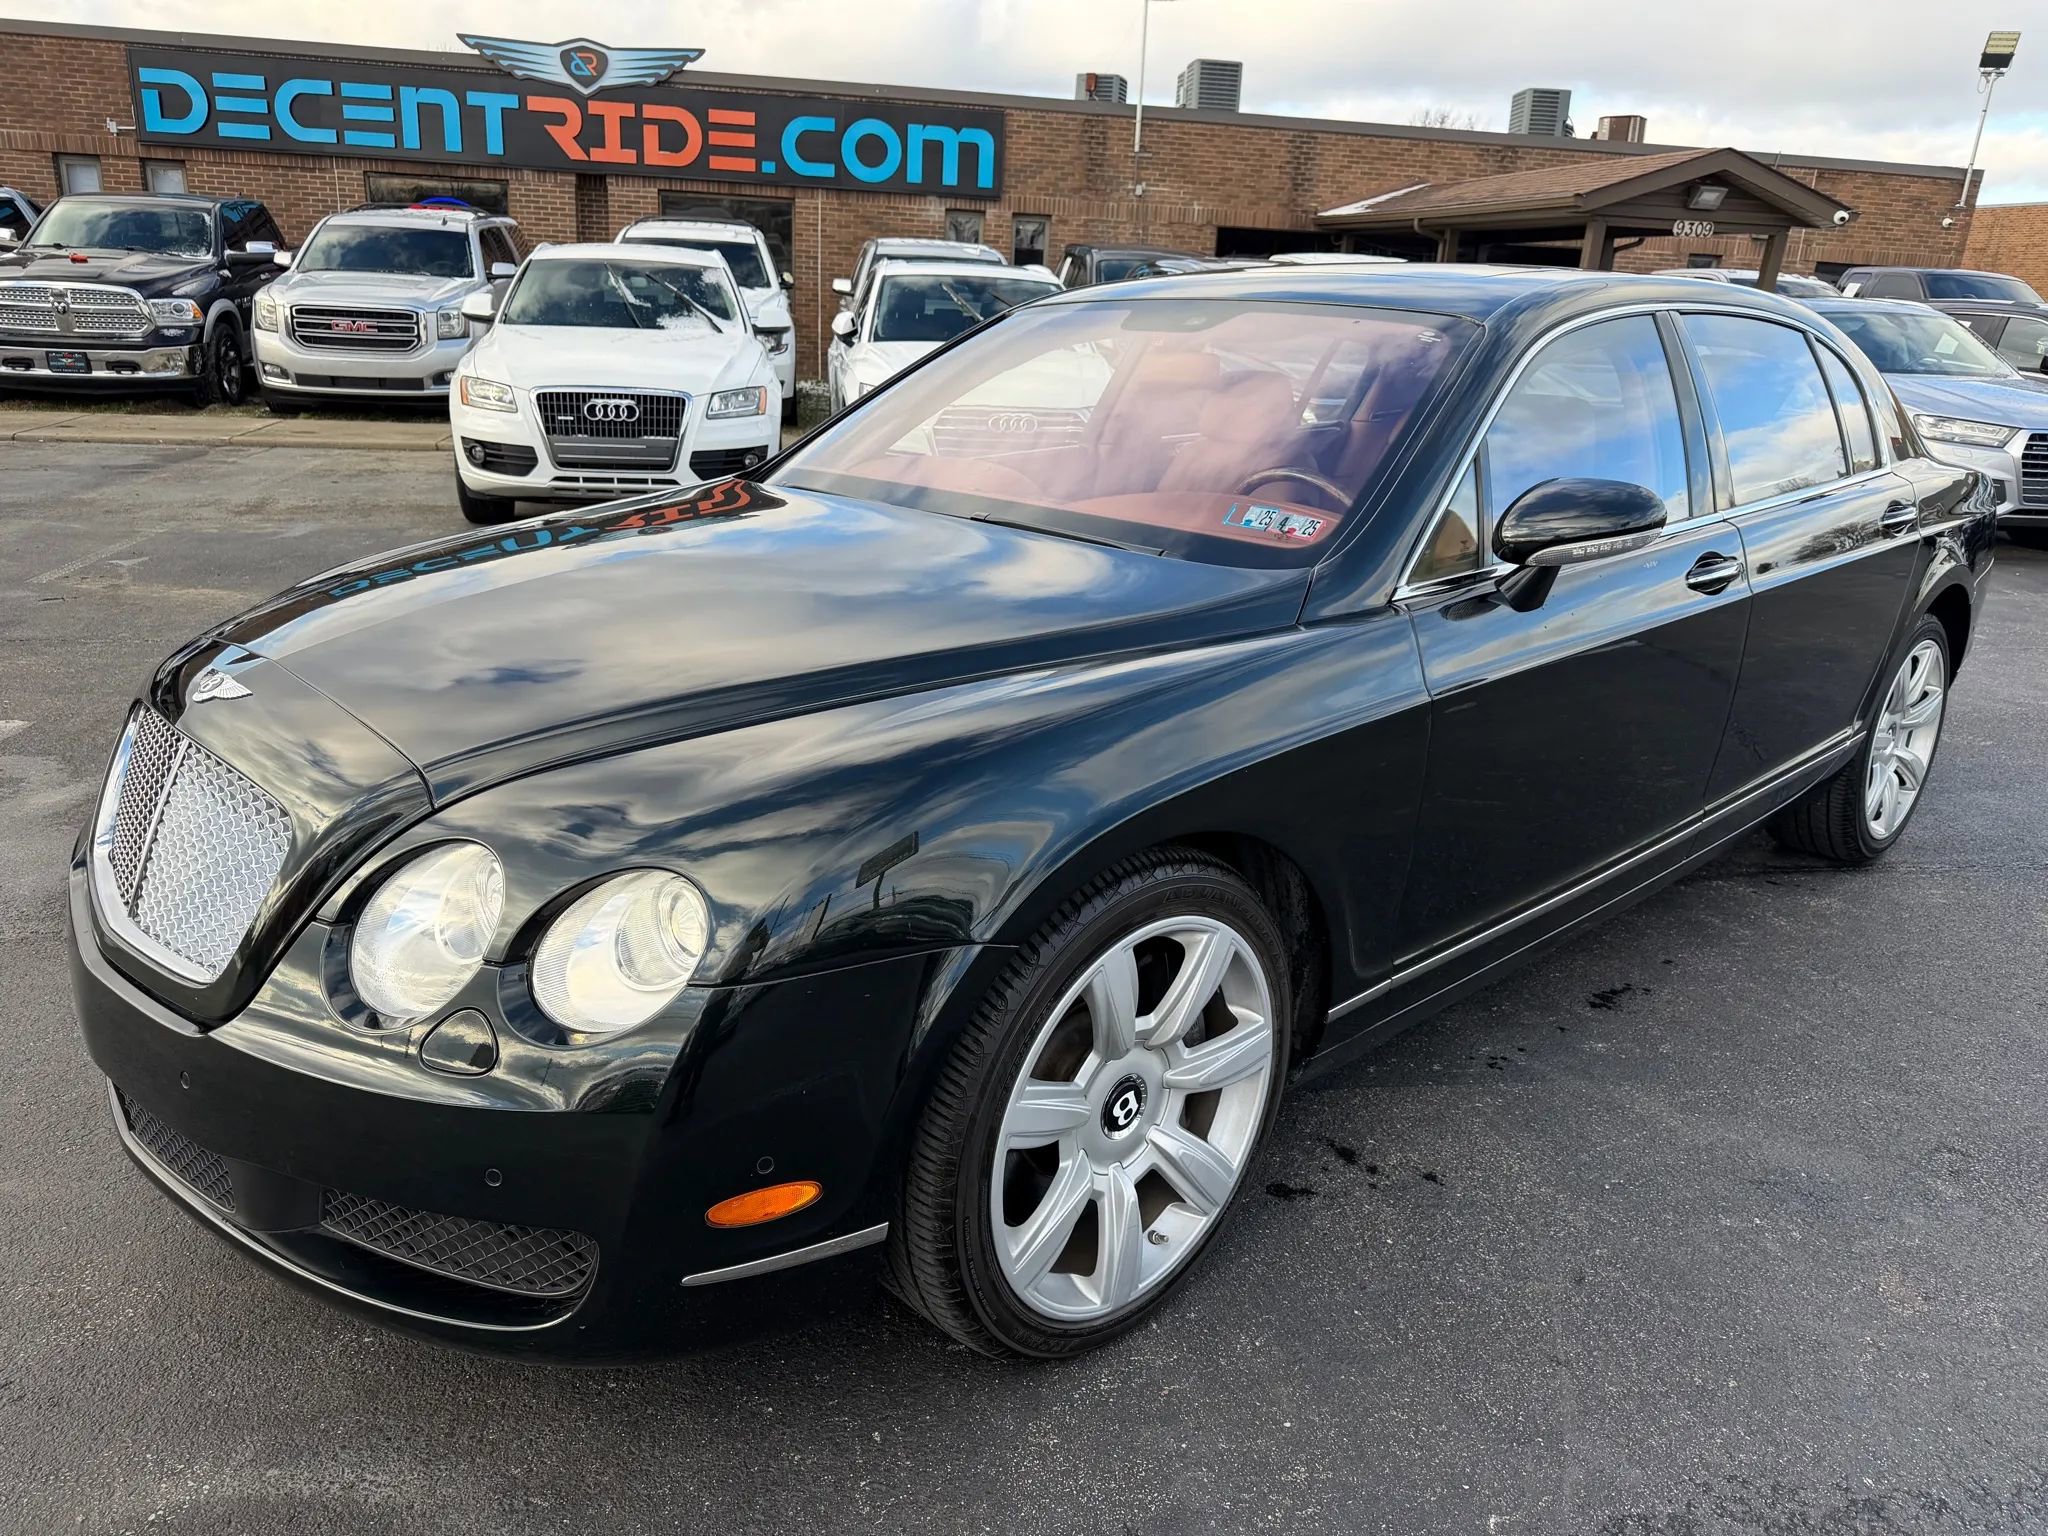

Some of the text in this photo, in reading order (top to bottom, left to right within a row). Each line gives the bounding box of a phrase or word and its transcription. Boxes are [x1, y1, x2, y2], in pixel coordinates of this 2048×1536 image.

[1676, 220, 1713, 238] 9309
[331, 320, 378, 333] GMC
[1301, 519, 1321, 537] 25
[1112, 1090, 1139, 1126] B
